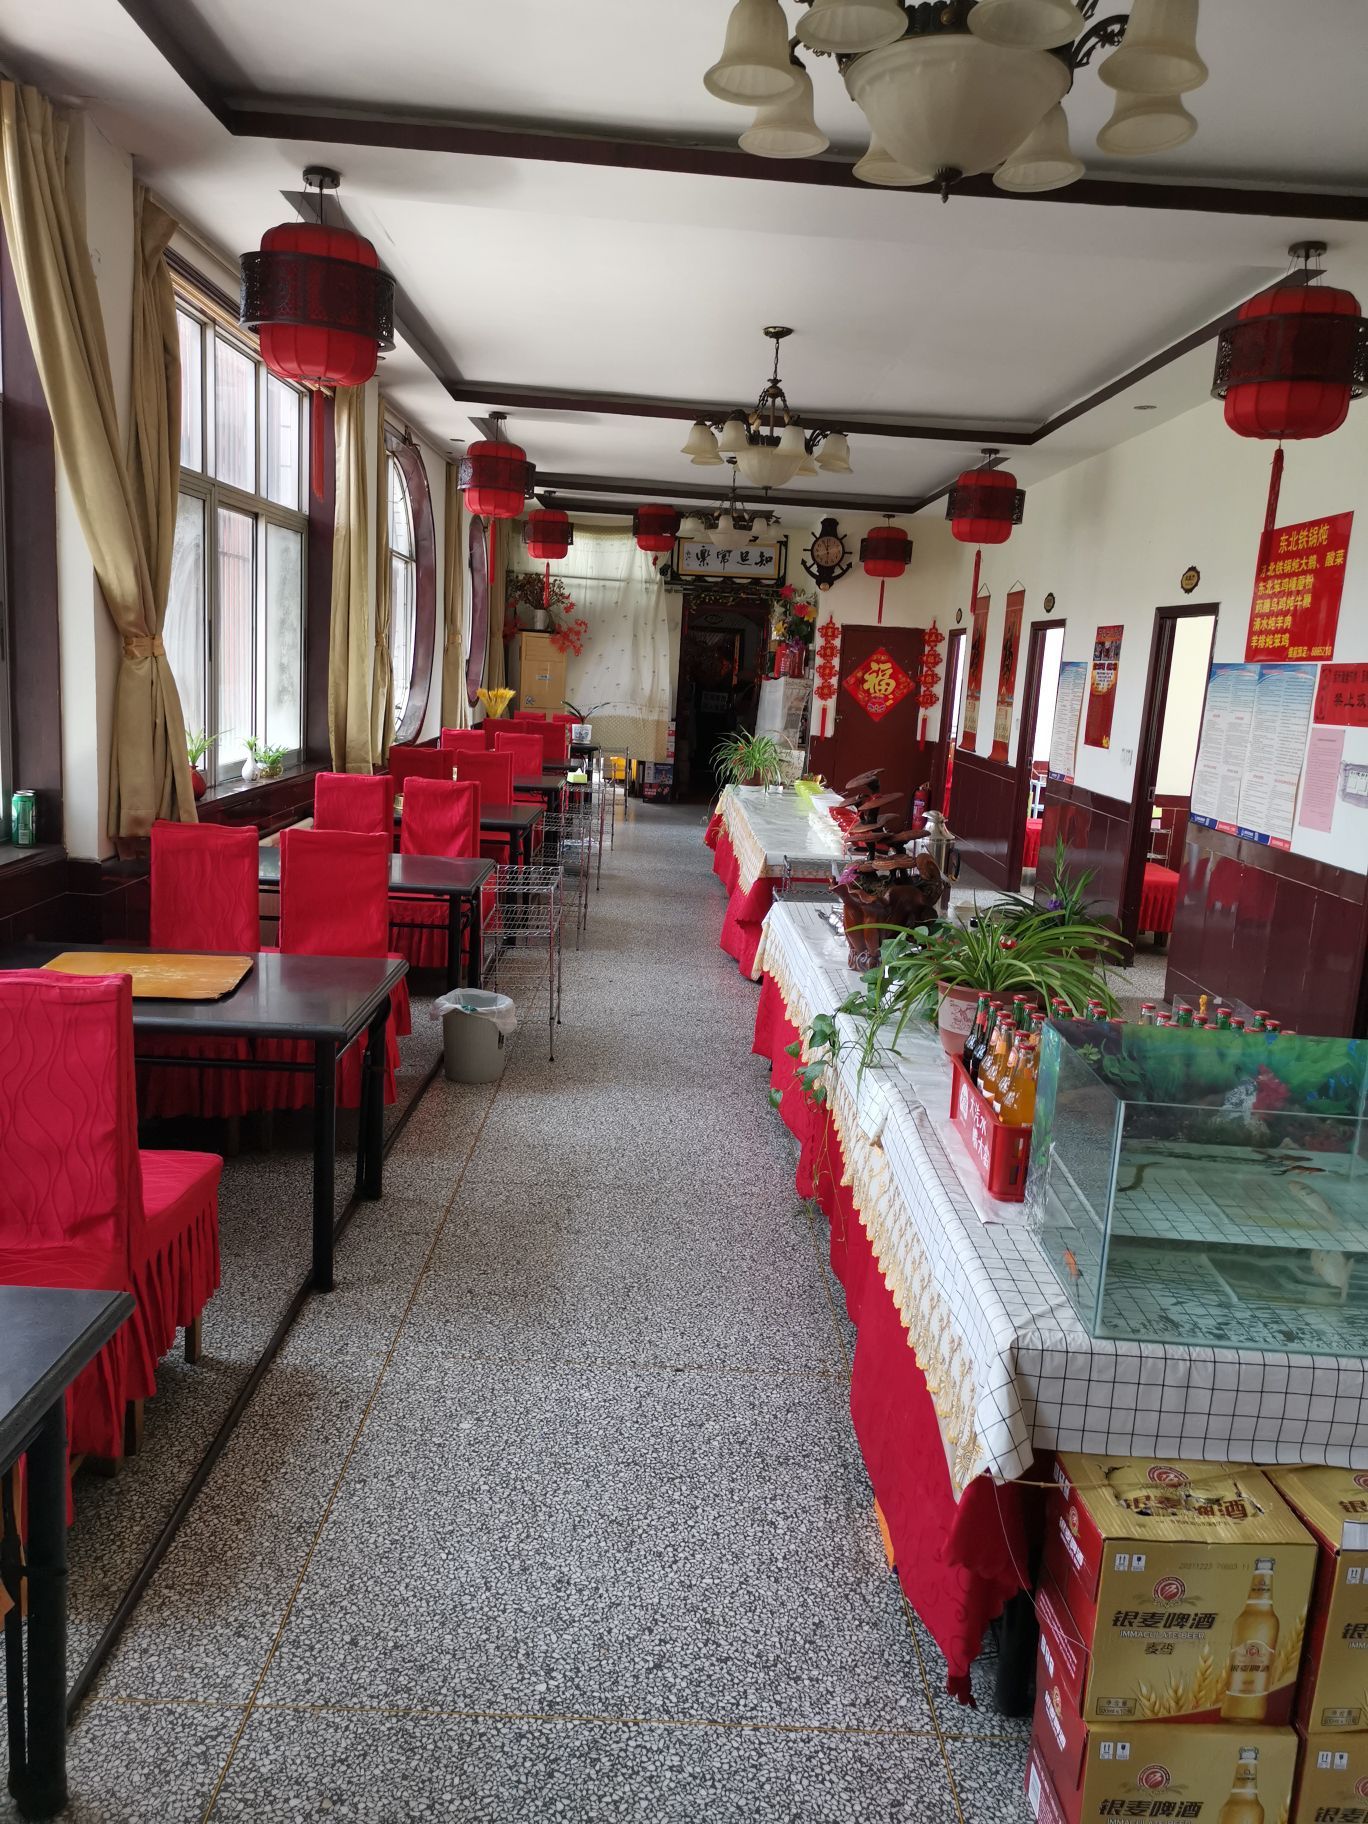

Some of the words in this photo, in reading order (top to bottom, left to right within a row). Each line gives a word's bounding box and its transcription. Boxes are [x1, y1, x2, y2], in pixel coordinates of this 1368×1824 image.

[1279, 523, 1329, 553] 东北铁锅炖
[1252, 615, 1292, 632] 清水炖羊肉
[863, 661, 896, 695] 福
[1112, 1610, 1219, 1630] 银麦啤酒
[1342, 1623, 1368, 1639] 银
[1100, 1799, 1204, 1818] 银麦啤酒
[1314, 1806, 1368, 1824] 银麦
